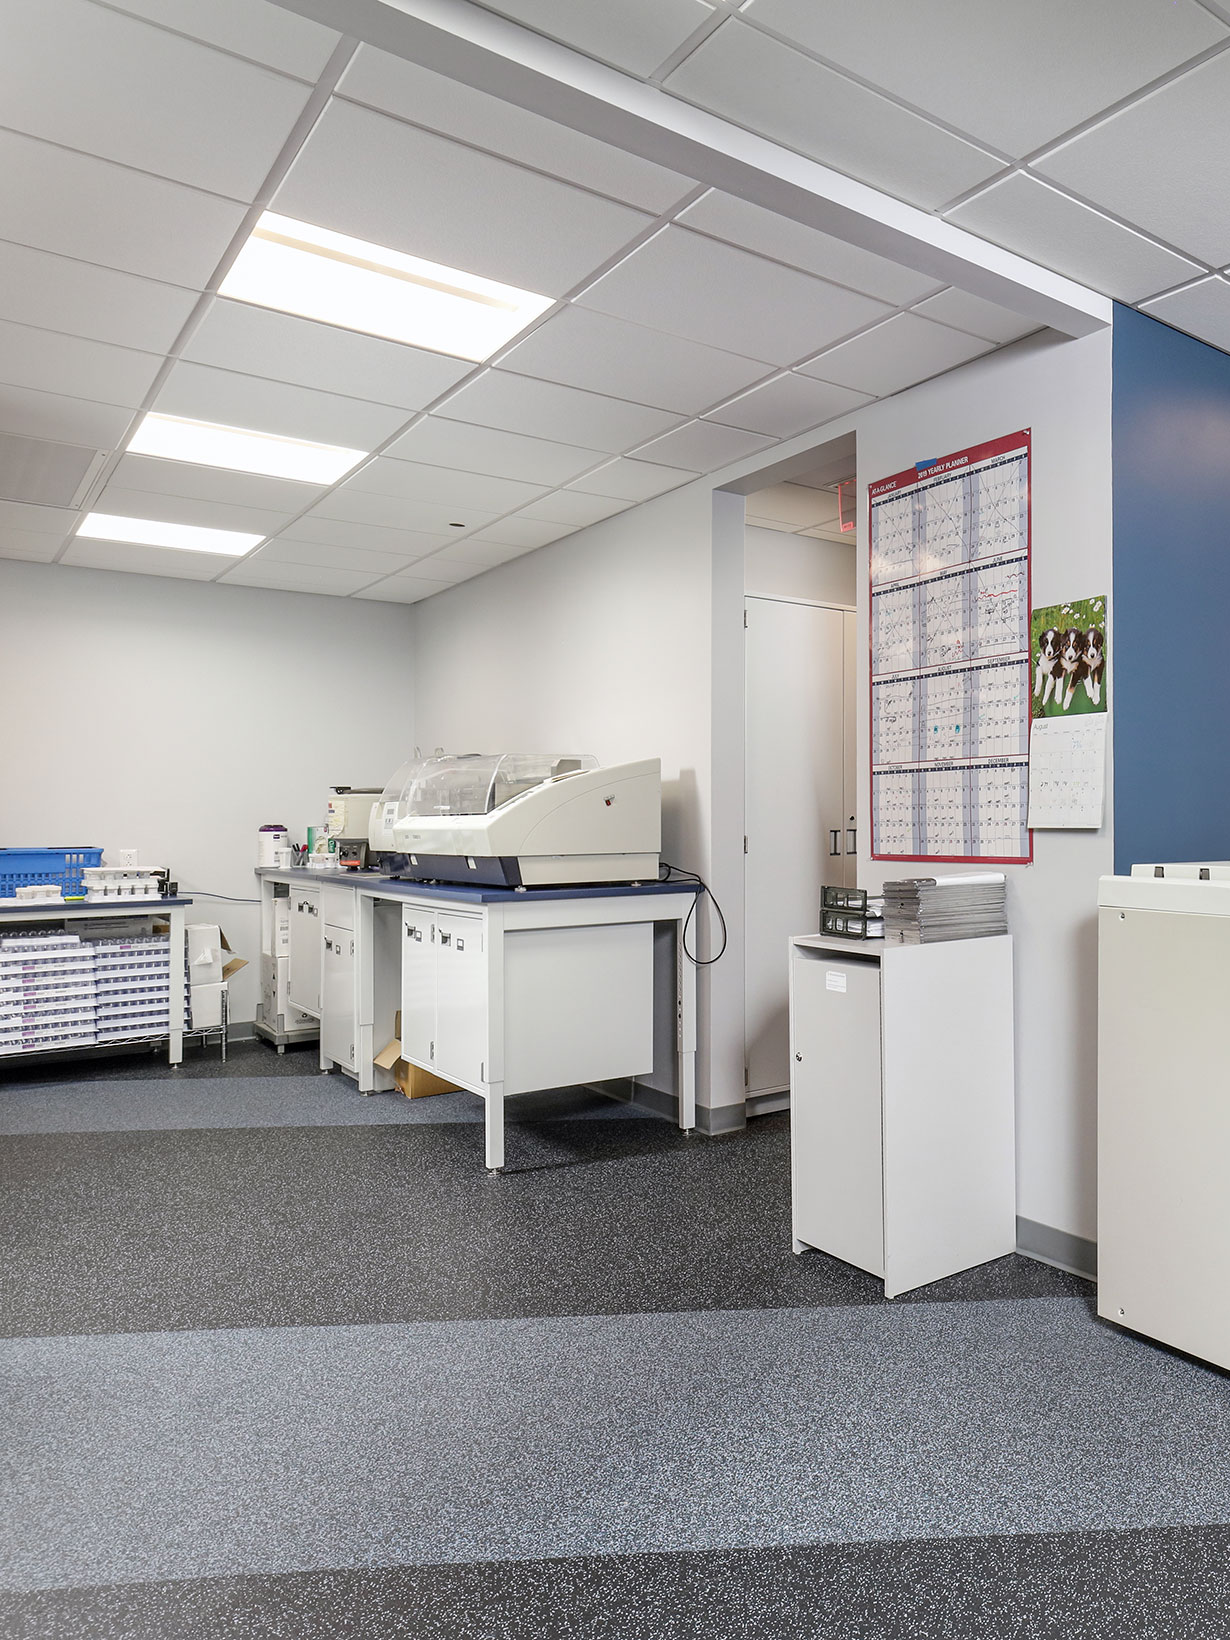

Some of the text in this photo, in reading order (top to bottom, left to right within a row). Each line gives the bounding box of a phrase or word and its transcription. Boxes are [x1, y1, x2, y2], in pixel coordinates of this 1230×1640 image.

[928, 464, 945, 477] YEARLY
[945, 456, 969, 470] PLANNER
[987, 656, 1011, 664] SEPTEMBER
